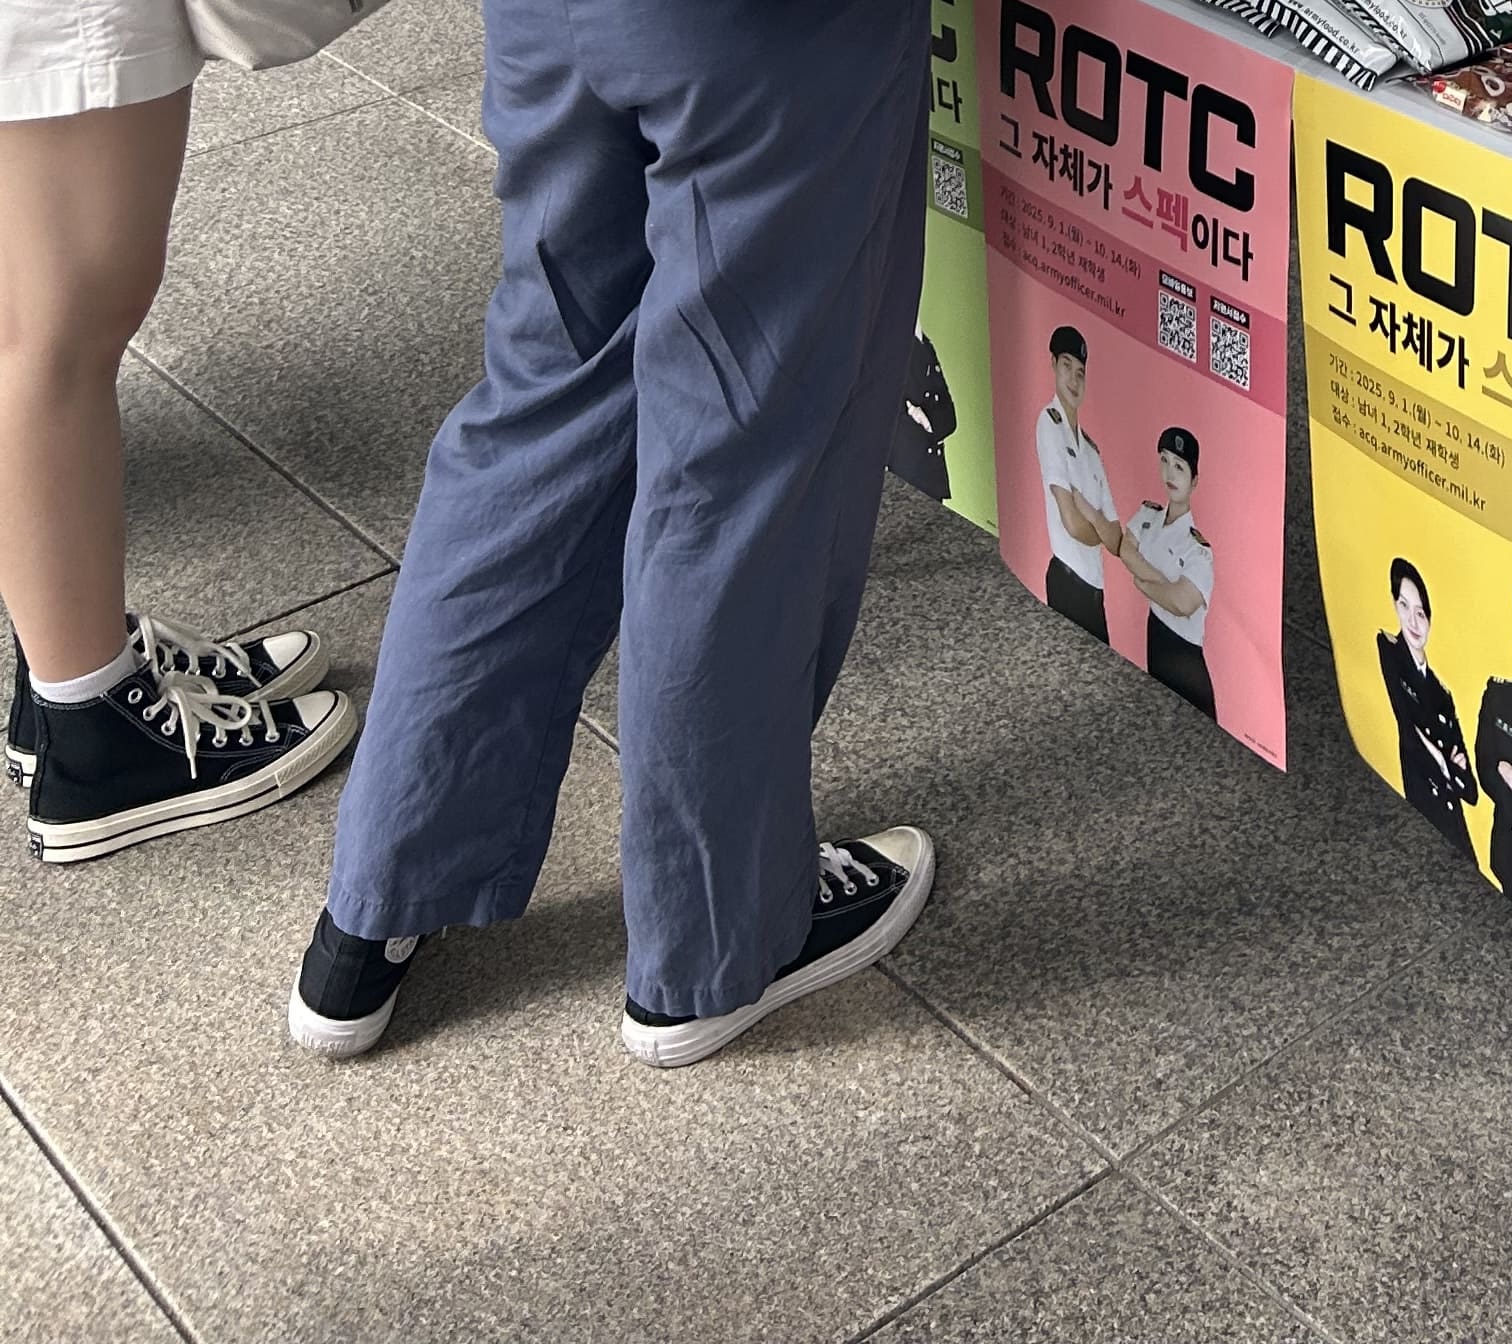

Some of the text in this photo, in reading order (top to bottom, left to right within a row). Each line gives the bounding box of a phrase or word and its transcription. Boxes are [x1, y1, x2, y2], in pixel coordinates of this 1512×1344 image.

[1000, 112, 1254, 282] 그 자체가 스펙이다
[1328, 273, 1357, 326] 그
[1369, 294, 1470, 390] 자체가
[1329, 353, 1506, 469] 기간 2025. 9. 1.(월) 10. 14.(화)
[1330, 380, 1460, 470] 대상 남녀 1, 2학년 재학생
[1332, 405, 1486, 511] 접수 acq.armyofficer.mil.kr
